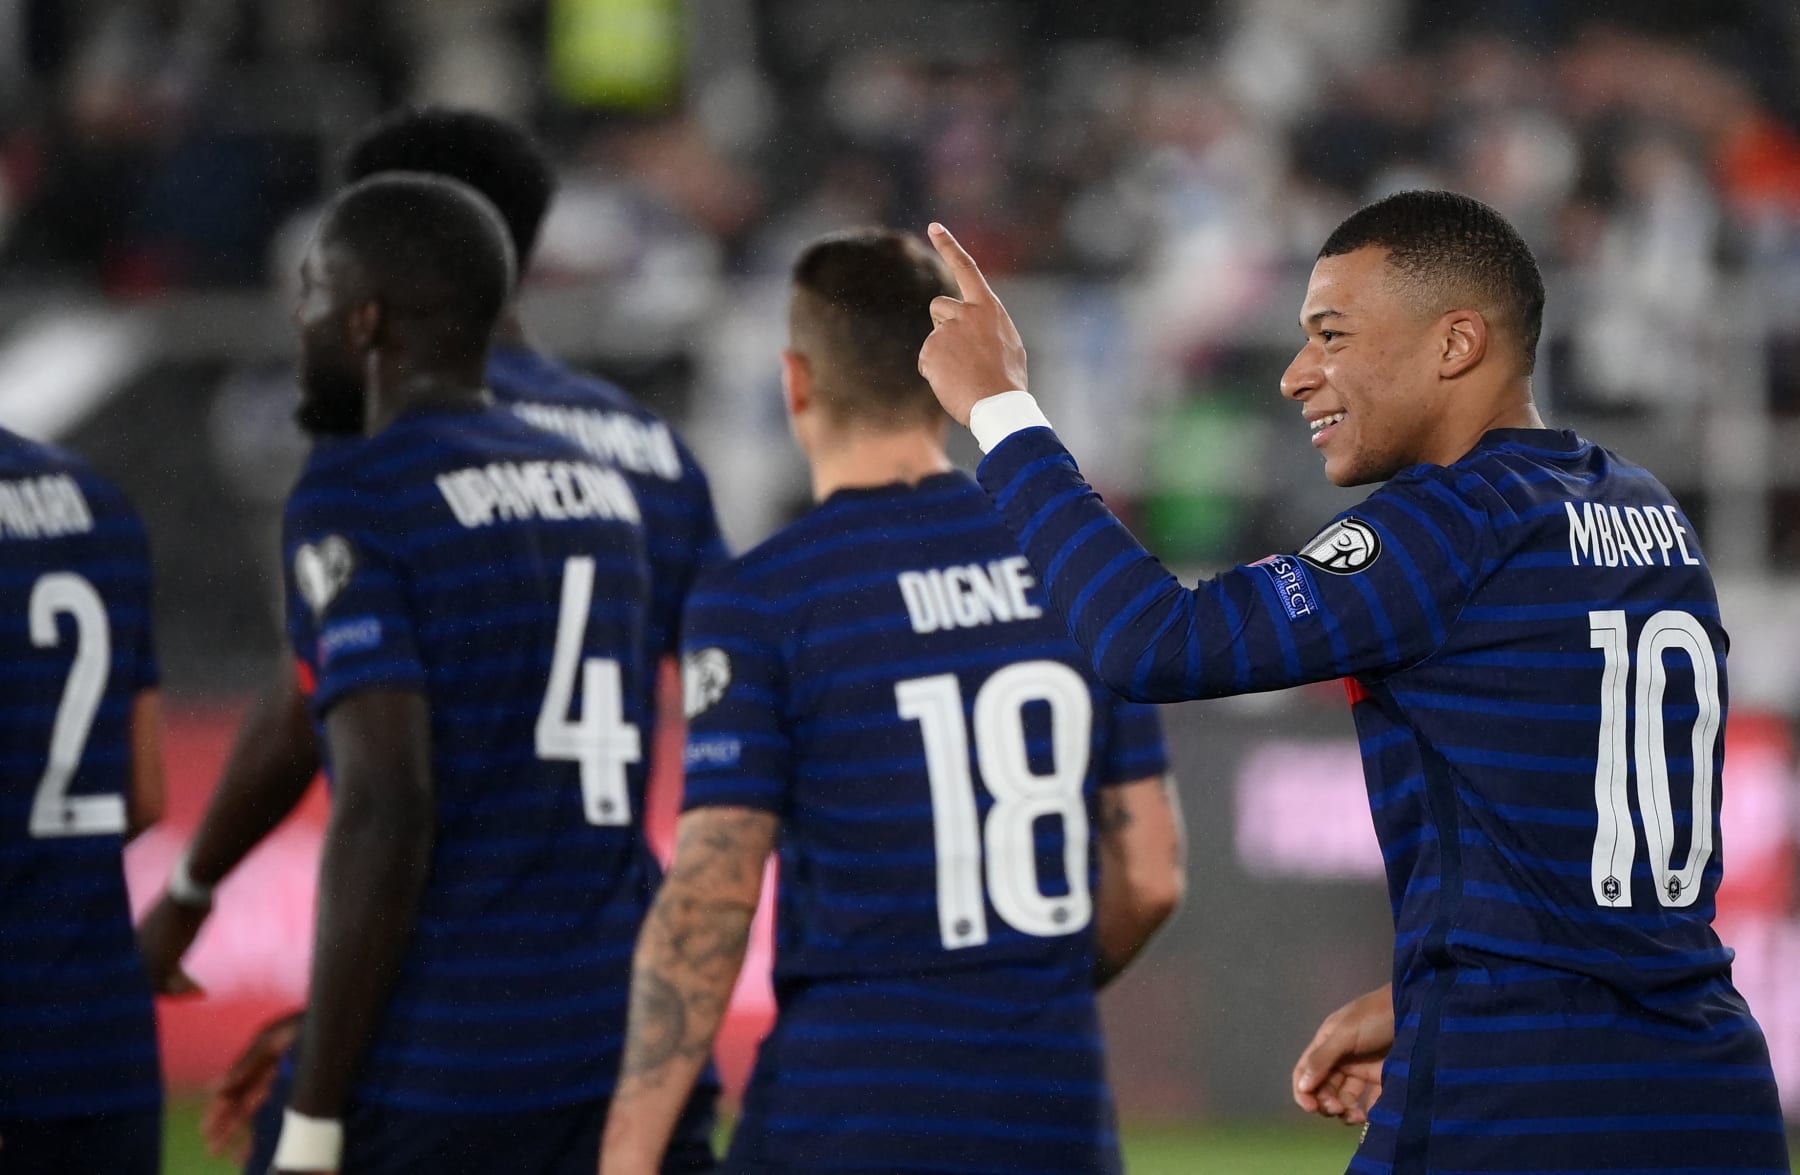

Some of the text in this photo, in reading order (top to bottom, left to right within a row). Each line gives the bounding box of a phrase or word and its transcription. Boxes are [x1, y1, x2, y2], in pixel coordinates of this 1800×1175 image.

[897, 555, 1042, 634] DIGNE
[1269, 558, 1311, 615] ESPECT
[1564, 501, 1701, 567] MBAPPE
[28, 572, 127, 836] 2
[535, 555, 641, 827] 4
[894, 659, 1093, 950] 18
[1589, 610, 1720, 908] 10
